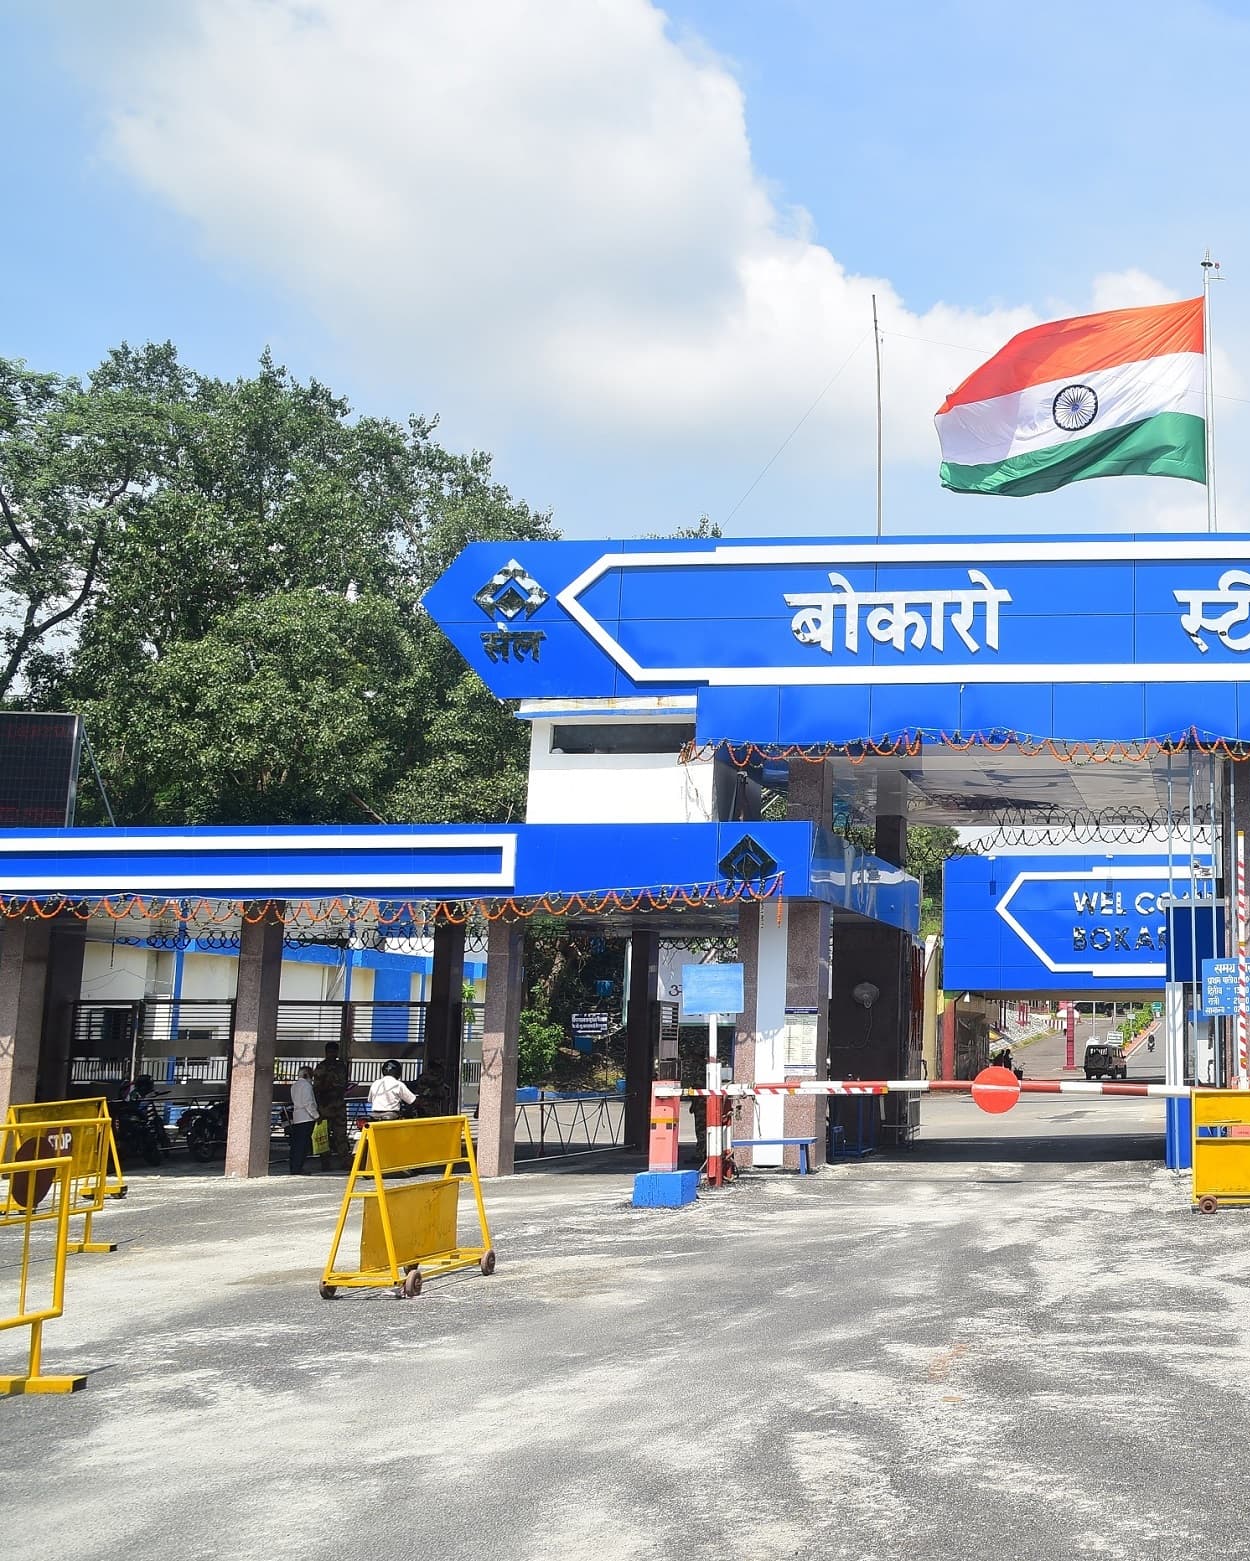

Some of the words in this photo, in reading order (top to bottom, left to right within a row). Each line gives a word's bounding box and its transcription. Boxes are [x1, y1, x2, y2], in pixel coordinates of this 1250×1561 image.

[783, 570, 1012, 653] बोकारो
[480, 621, 548, 664] सेल
[1073, 926, 1167, 951] BOKAR
